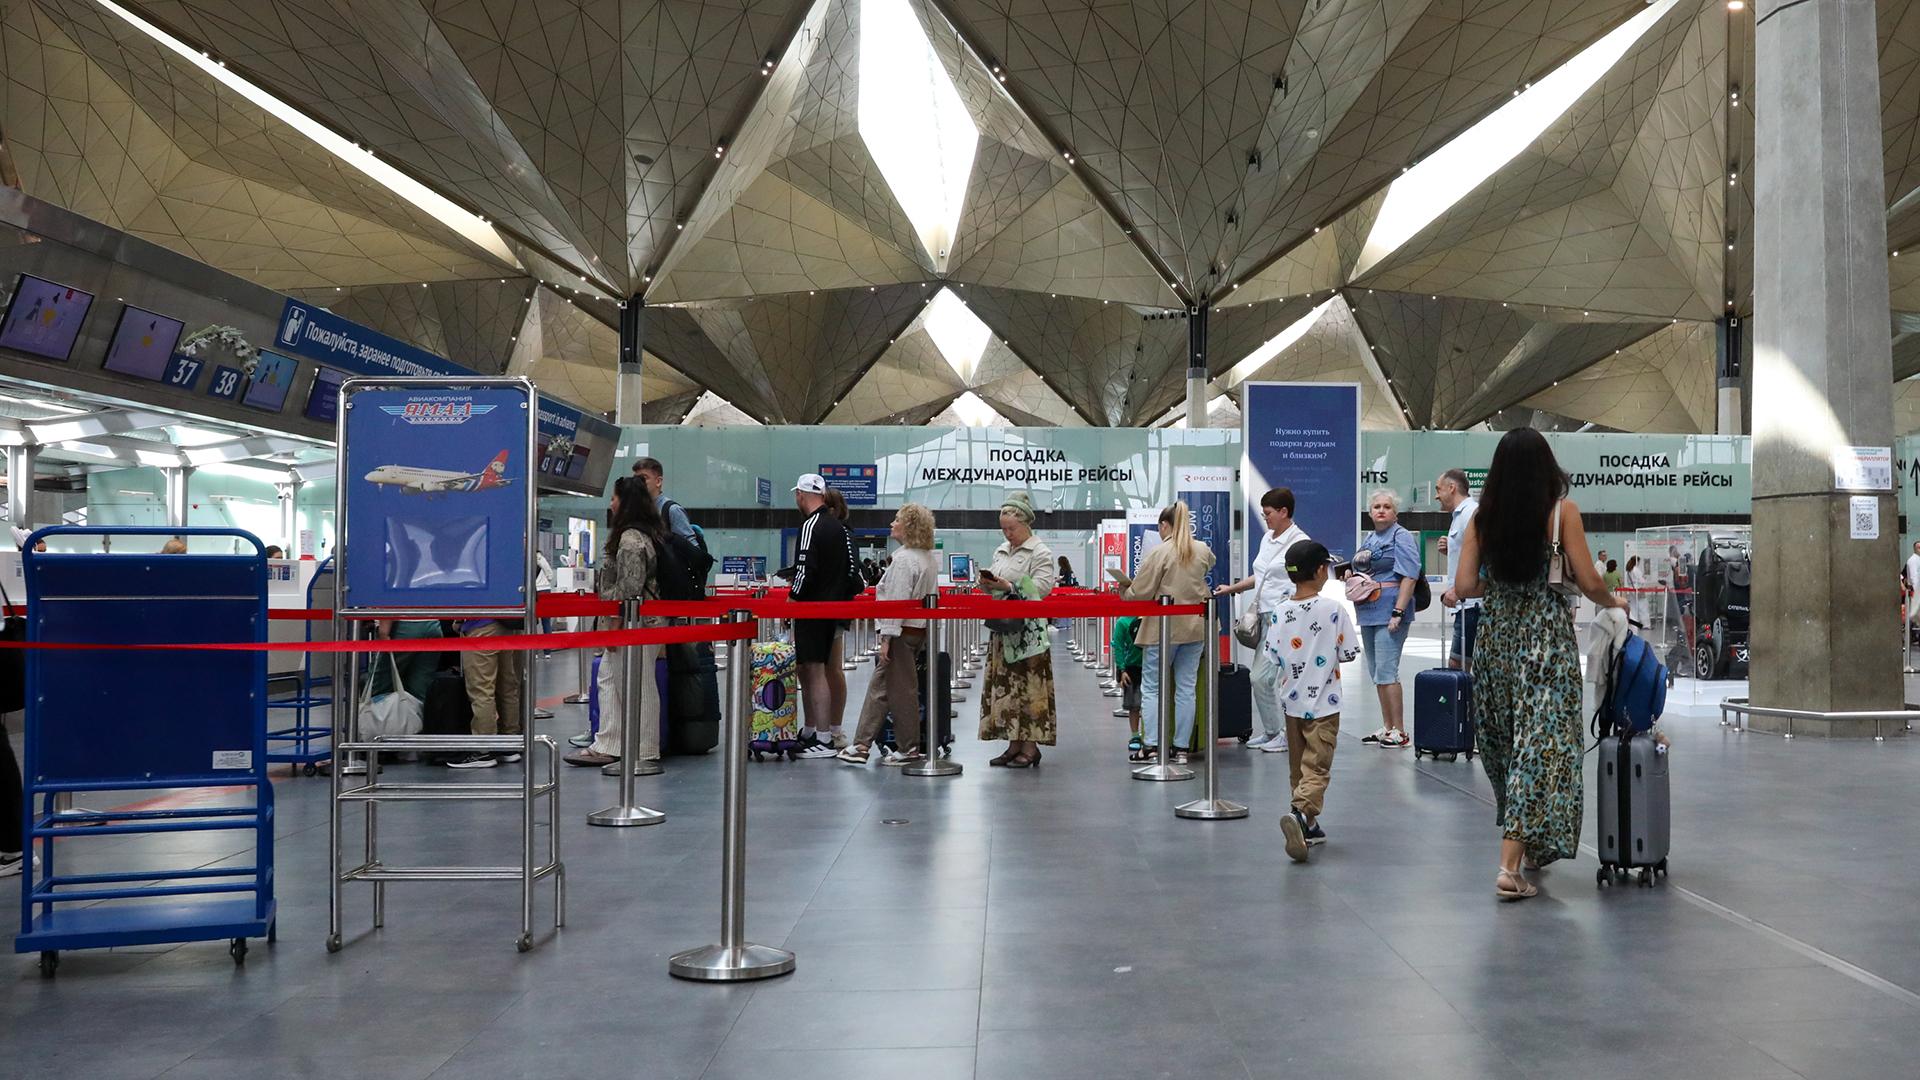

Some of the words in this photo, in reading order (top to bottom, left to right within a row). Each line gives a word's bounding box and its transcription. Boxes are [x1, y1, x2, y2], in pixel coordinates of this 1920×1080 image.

[304, 320, 357, 359] Пожалуйста,
[358, 343, 390, 366] заранее
[172, 359, 198, 385] 37
[214, 370, 237, 396] 38
[403, 402, 472, 417] ЯМАЛ
[1275, 428, 1301, 436] Нужно
[990, 450, 1066, 464] ПОСАДКА
[1600, 455, 1670, 470] ПОСАДКА
[555, 460, 565, 475] 44
[922, 468, 1073, 483] МЕЖДУНАРОДНЫЕ
[1078, 465, 1132, 482] РЕЙСЫ
[1360, 471, 1389, 484] HTS
[1683, 471, 1732, 487] РЕЙСЫ
